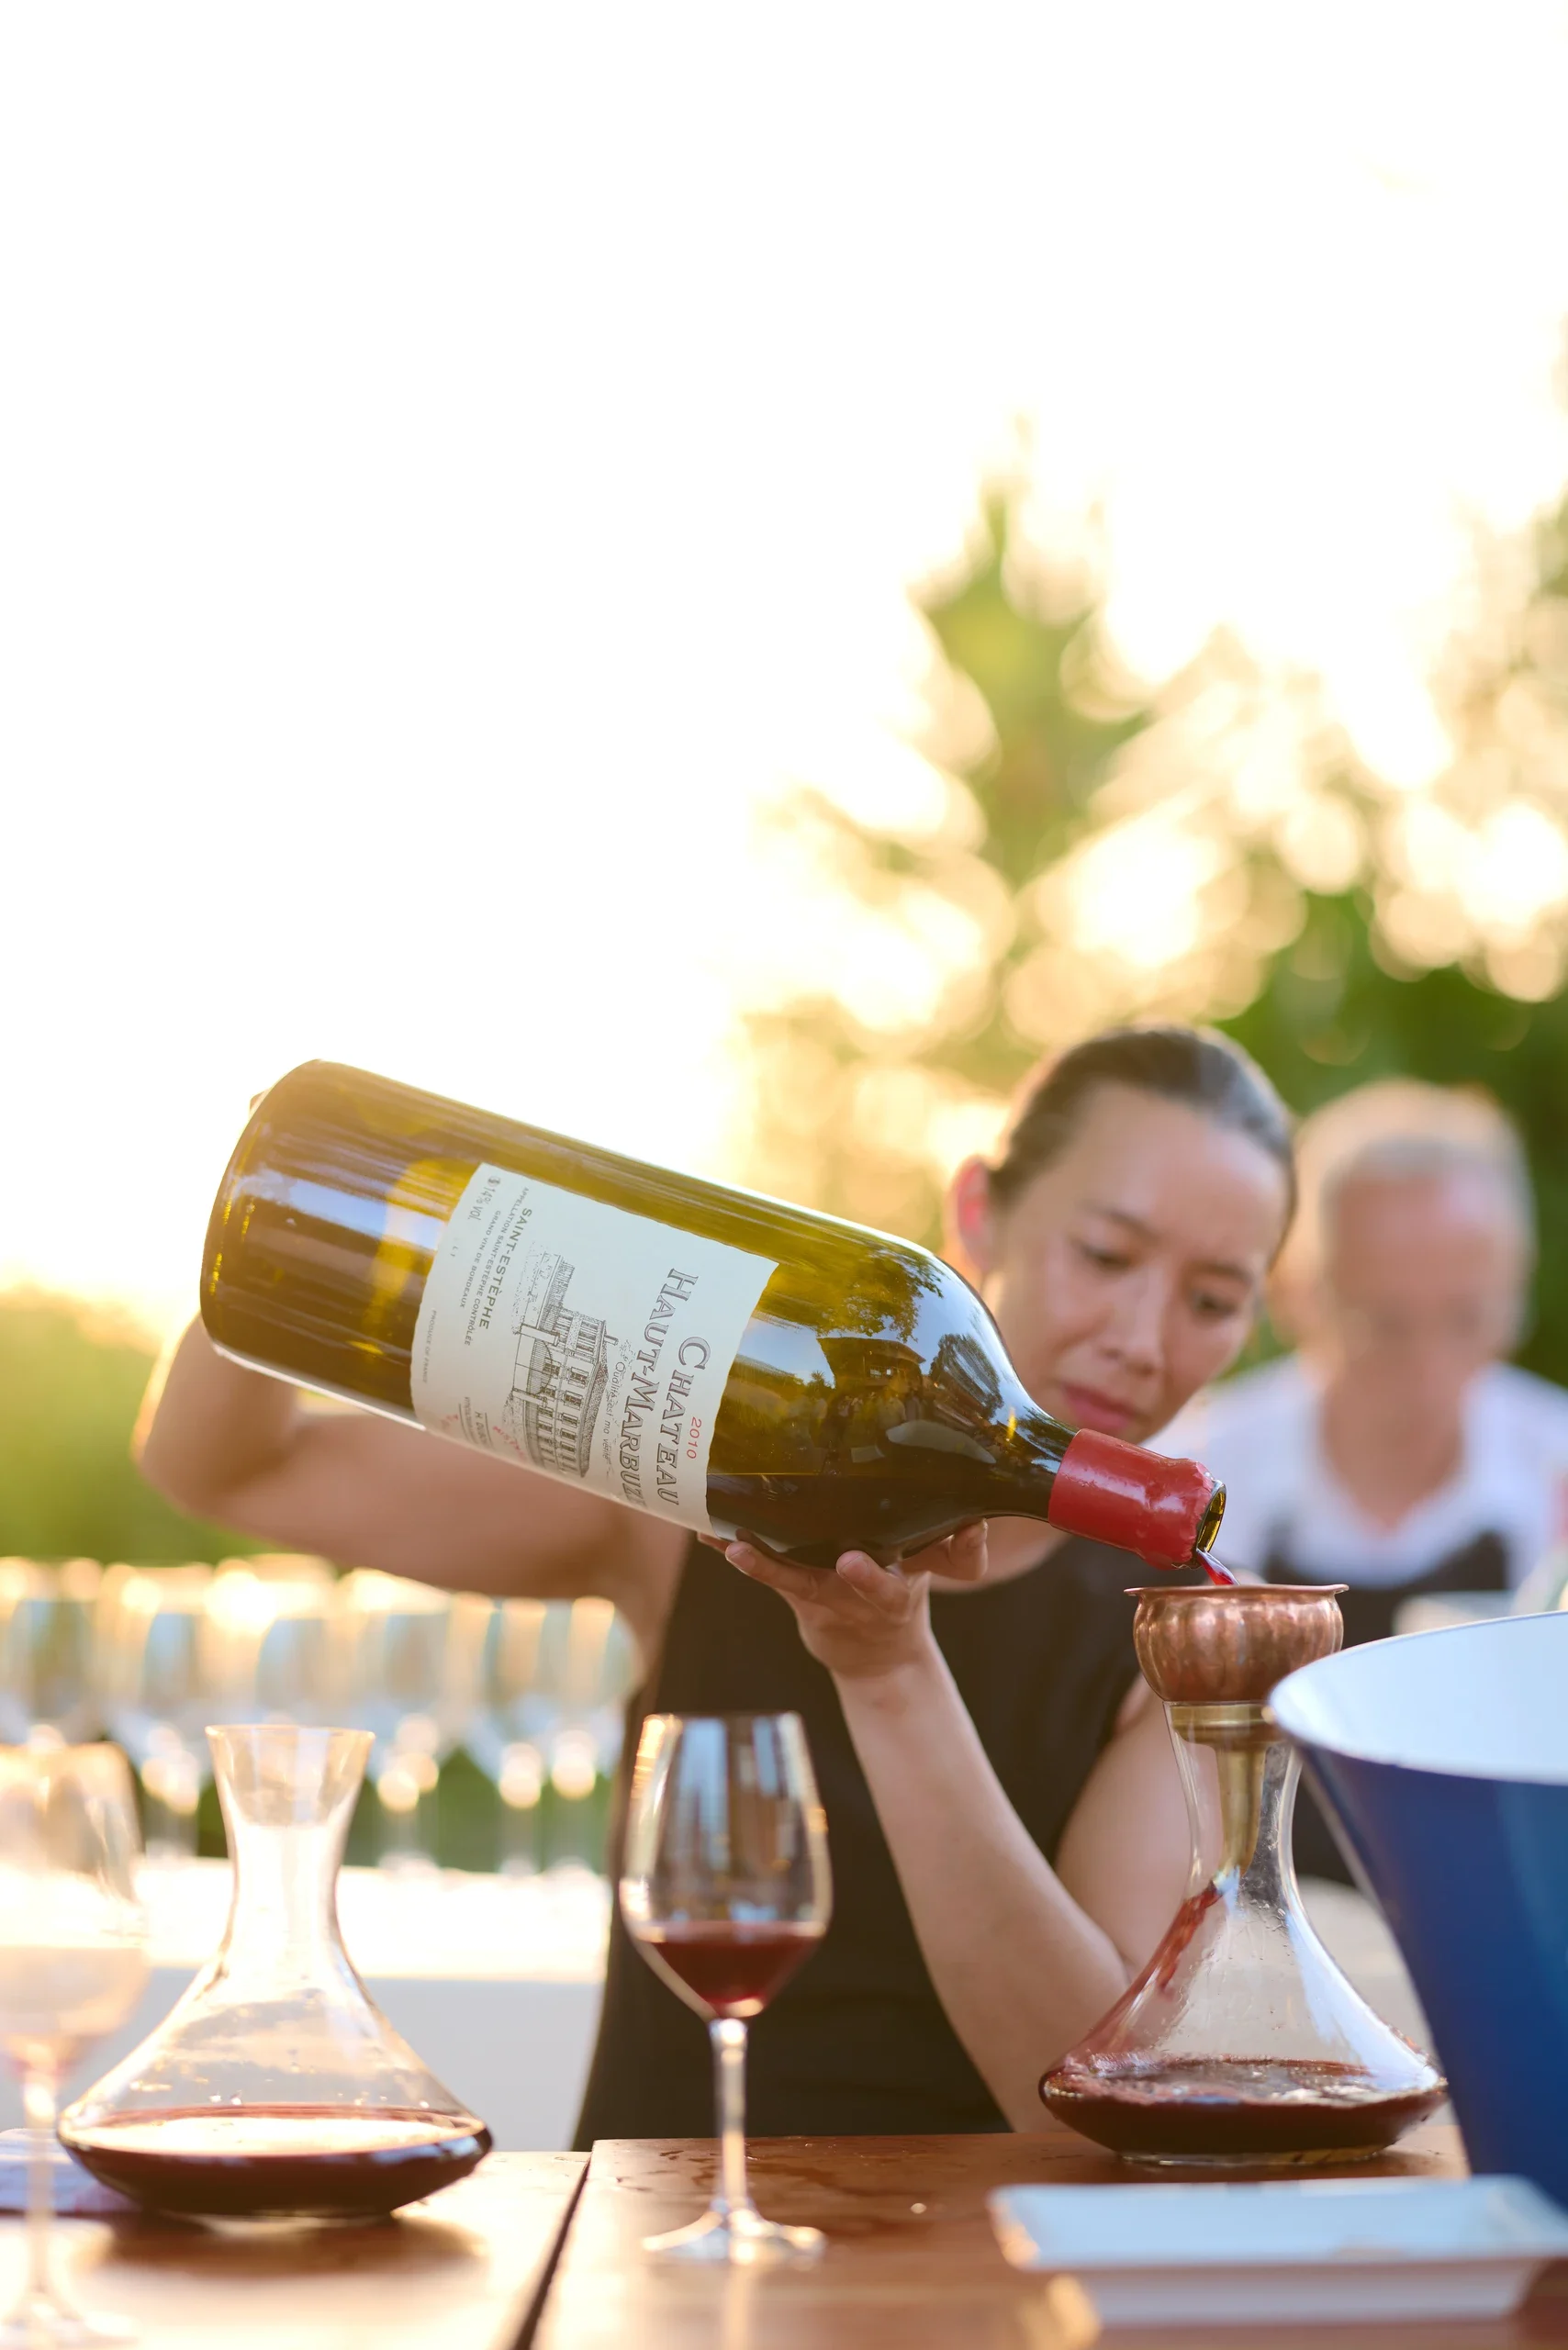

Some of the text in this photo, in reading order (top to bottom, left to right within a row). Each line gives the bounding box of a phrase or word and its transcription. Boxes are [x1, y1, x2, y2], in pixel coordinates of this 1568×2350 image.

[476, 1186, 497, 1205] 14%
[459, 1210, 501, 1308] GRAND VIN DE BORDEAUX
[464, 1187, 530, 1346] APPELLATION SAINT-ESTÈPHE CONTRÔLÉE
[478, 1207, 532, 1329] SAINT-ESTÈPHE
[656, 1336, 711, 1505] CHATEAU
[686, 1416, 702, 1460] 2010
